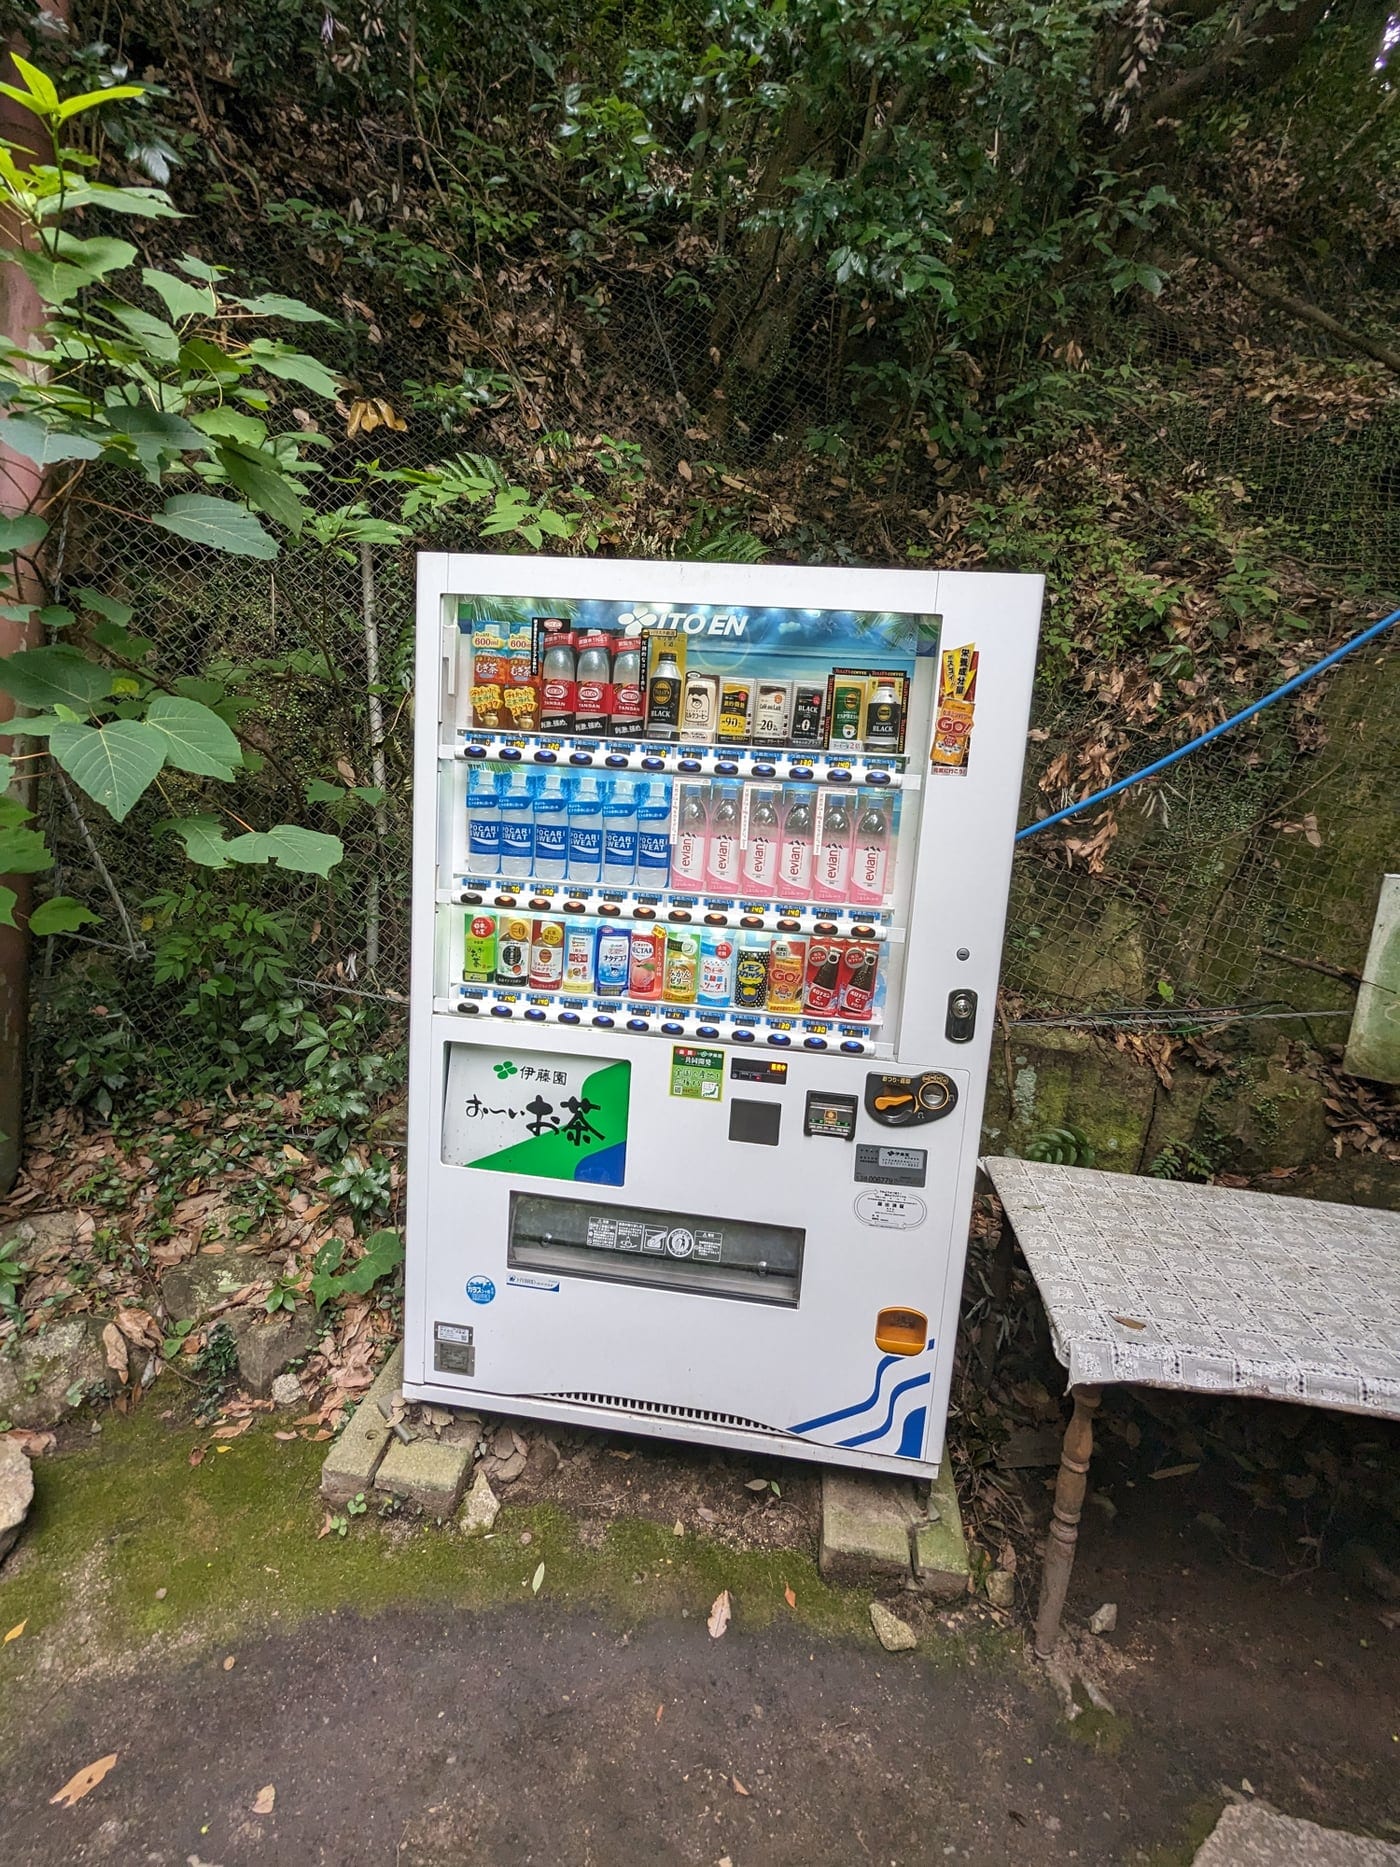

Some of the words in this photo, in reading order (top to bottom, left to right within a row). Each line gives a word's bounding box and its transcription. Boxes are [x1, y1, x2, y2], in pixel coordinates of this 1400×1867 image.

[657, 613, 706, 634] ITO
[708, 614, 749, 636] EN
[476, 662, 499, 675] むぎ茶
[651, 709, 671, 718] BLACK
[798, 704, 818, 713] BLACK
[725, 717, 738, 727] 90
[761, 719, 773, 731] 20
[801, 719, 811, 731] 0
[937, 716, 971, 734] GO!
[607, 834, 635, 843] OCARI
[607, 841, 631, 849] WEAT
[681, 838, 692, 867] evian
[718, 840, 728, 870] evian
[754, 843, 765, 873] evian
[790, 846, 801, 876] evian
[826, 849, 838, 879] evian
[865, 852, 876, 882] evian
[770, 969, 801, 983] GO!
[684, 1056, 712, 1067] 共同開発
[520, 1066, 568, 1086] 伊藤園
